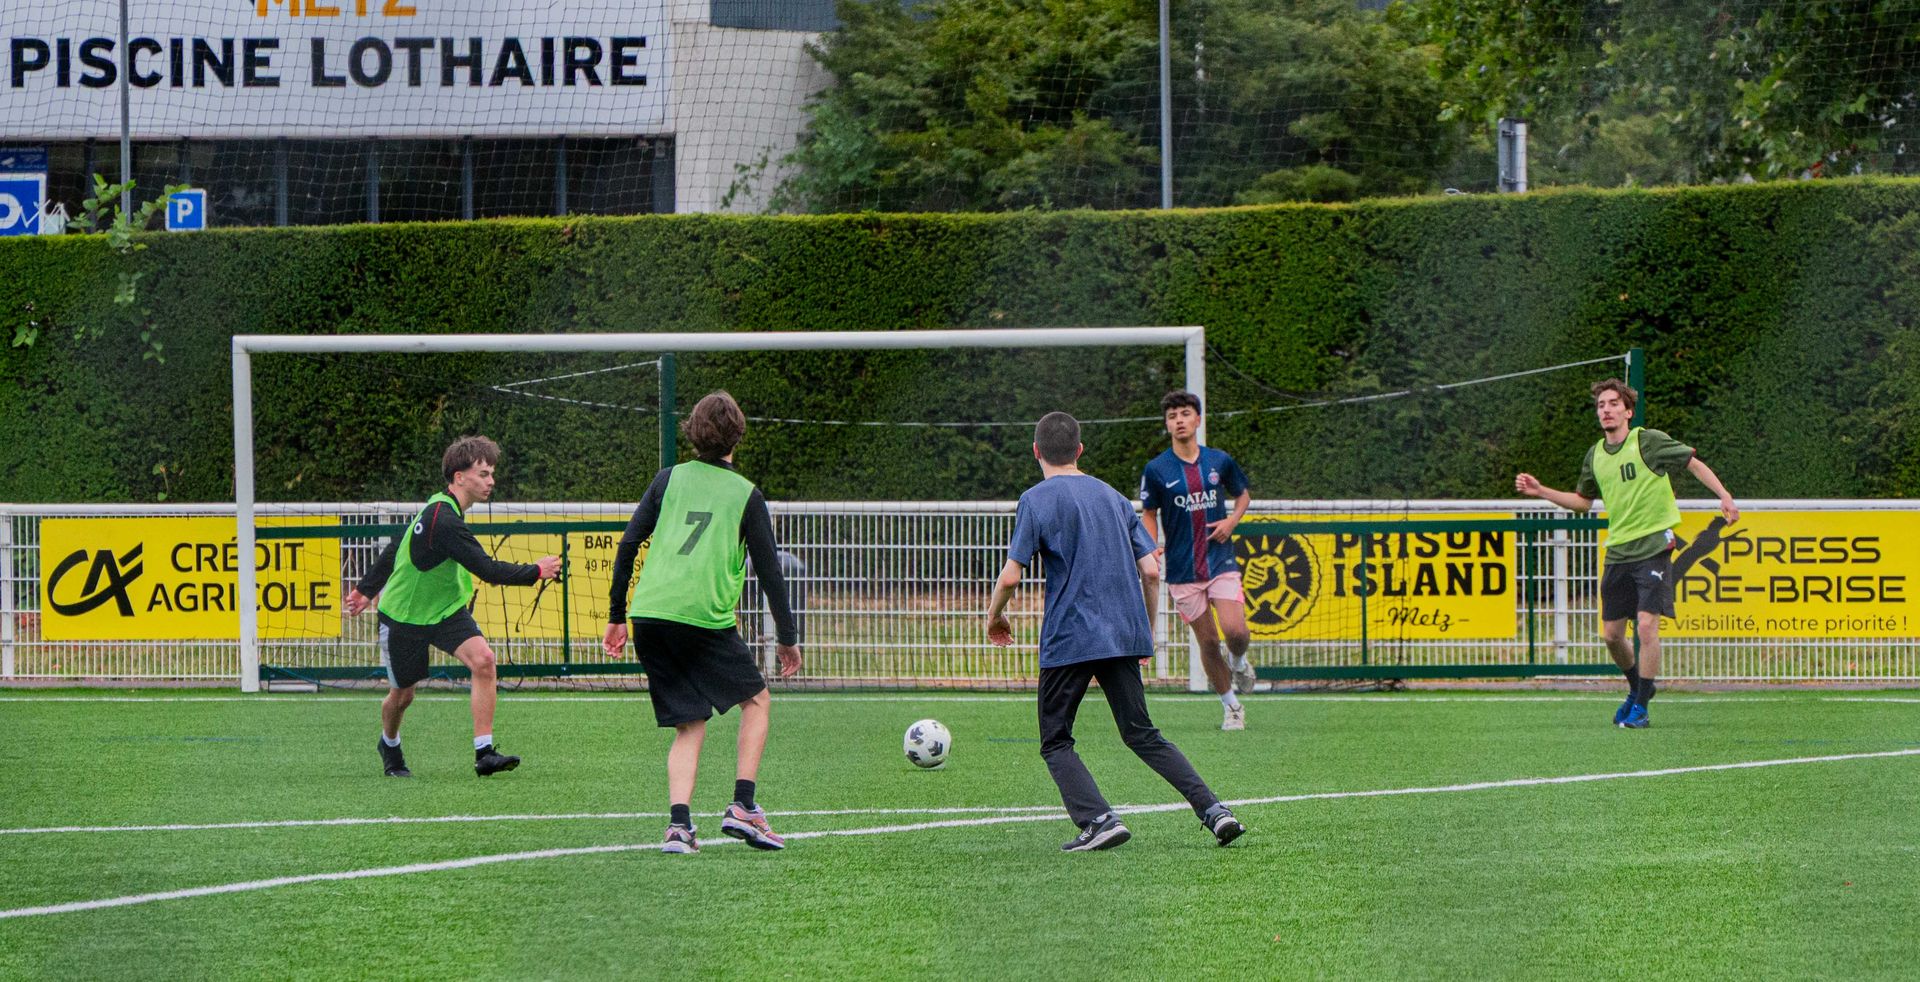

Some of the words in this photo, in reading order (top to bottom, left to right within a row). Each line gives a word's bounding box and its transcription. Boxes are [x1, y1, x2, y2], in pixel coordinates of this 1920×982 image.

[10, 37, 280, 88] PISCINE
[311, 36, 647, 88] LOTHAIRE
[177, 199, 194, 223] P
[1619, 461, 1637, 483] 10
[1174, 489, 1217, 508] QATAR
[584, 535, 613, 550] BAR
[677, 511, 713, 556] 7
[1334, 562, 1508, 597] ISLAND
[147, 581, 332, 613] AGRIOLE
[1675, 615, 1760, 633] visibilité,
[1766, 617, 1819, 631] notre
[1825, 614, 1897, 634] priorité
